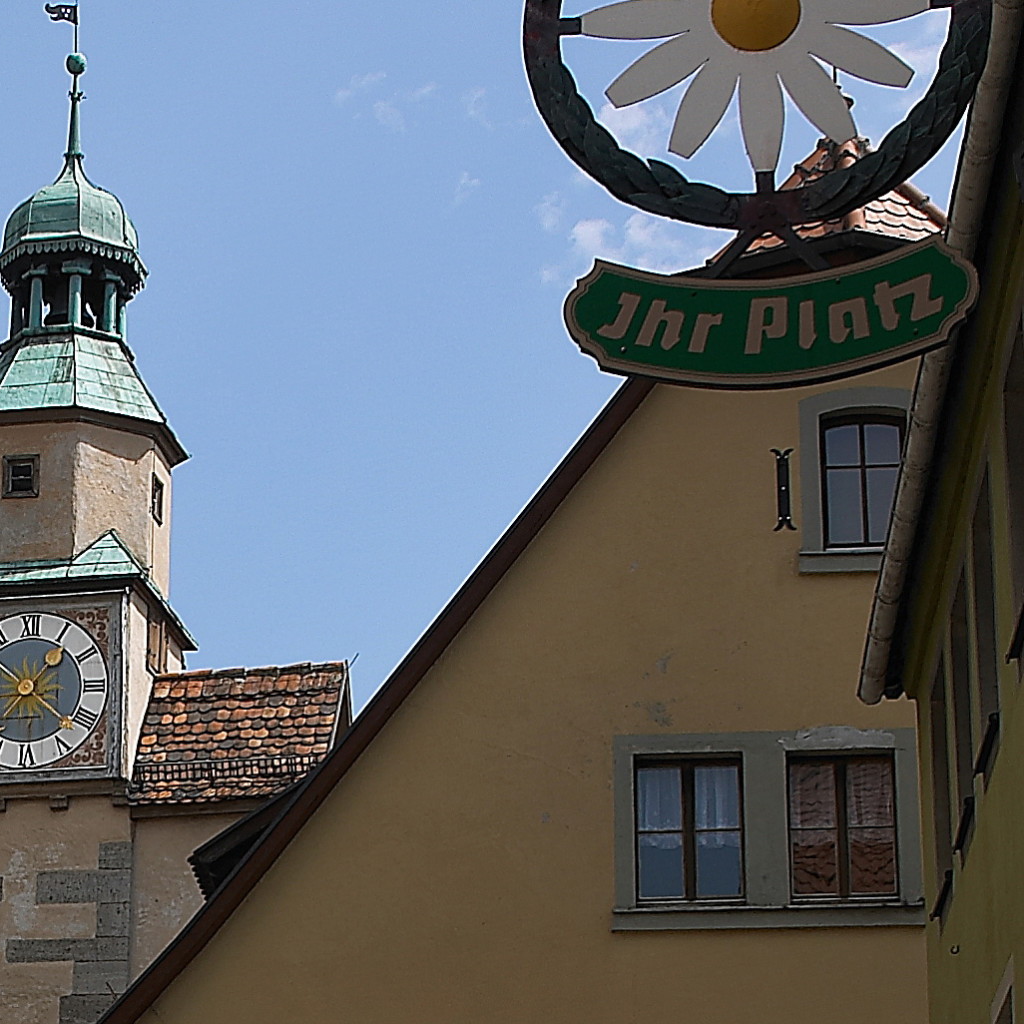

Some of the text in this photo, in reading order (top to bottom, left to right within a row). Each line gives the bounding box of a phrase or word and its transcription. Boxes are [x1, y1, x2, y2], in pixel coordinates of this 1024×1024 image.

[744, 273, 944, 355] Platz
[20, 615, 42, 637] XII
[55, 622, 71, 642] I
[75, 645, 98, 663] II
[83, 678, 105, 693] III
[18, 744, 36, 766] VI
[54, 735, 73, 756] V
